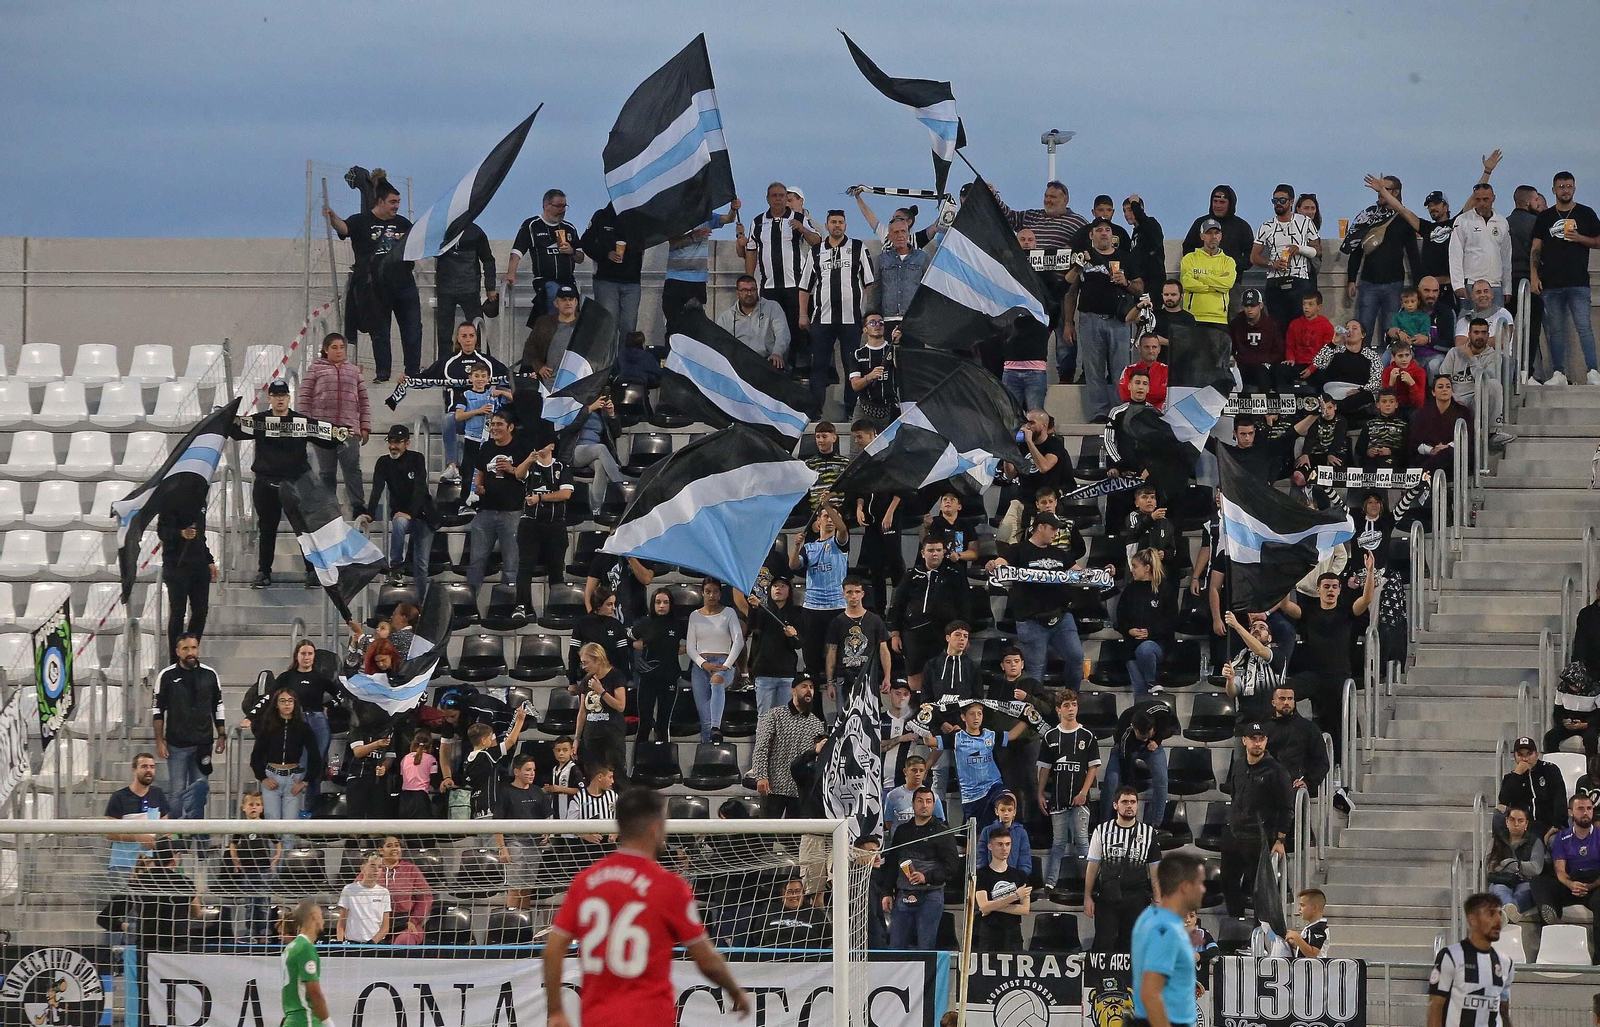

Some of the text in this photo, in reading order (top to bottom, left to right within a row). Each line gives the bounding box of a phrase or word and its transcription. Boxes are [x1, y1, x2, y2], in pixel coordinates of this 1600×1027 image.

[1247, 332, 1261, 346] T
[1267, 399, 1296, 409] LINENSE
[1320, 471, 1420, 483] REAL BALOMPEDICA LINENSE
[966, 755, 992, 764] LOTUS
[1054, 763, 1080, 772] LOTUS
[578, 897, 650, 979] 26
[958, 952, 1082, 978] ULTRAS
[1090, 952, 1131, 971] WE ARE
[986, 979, 1058, 1006] AGAINST MODERN
